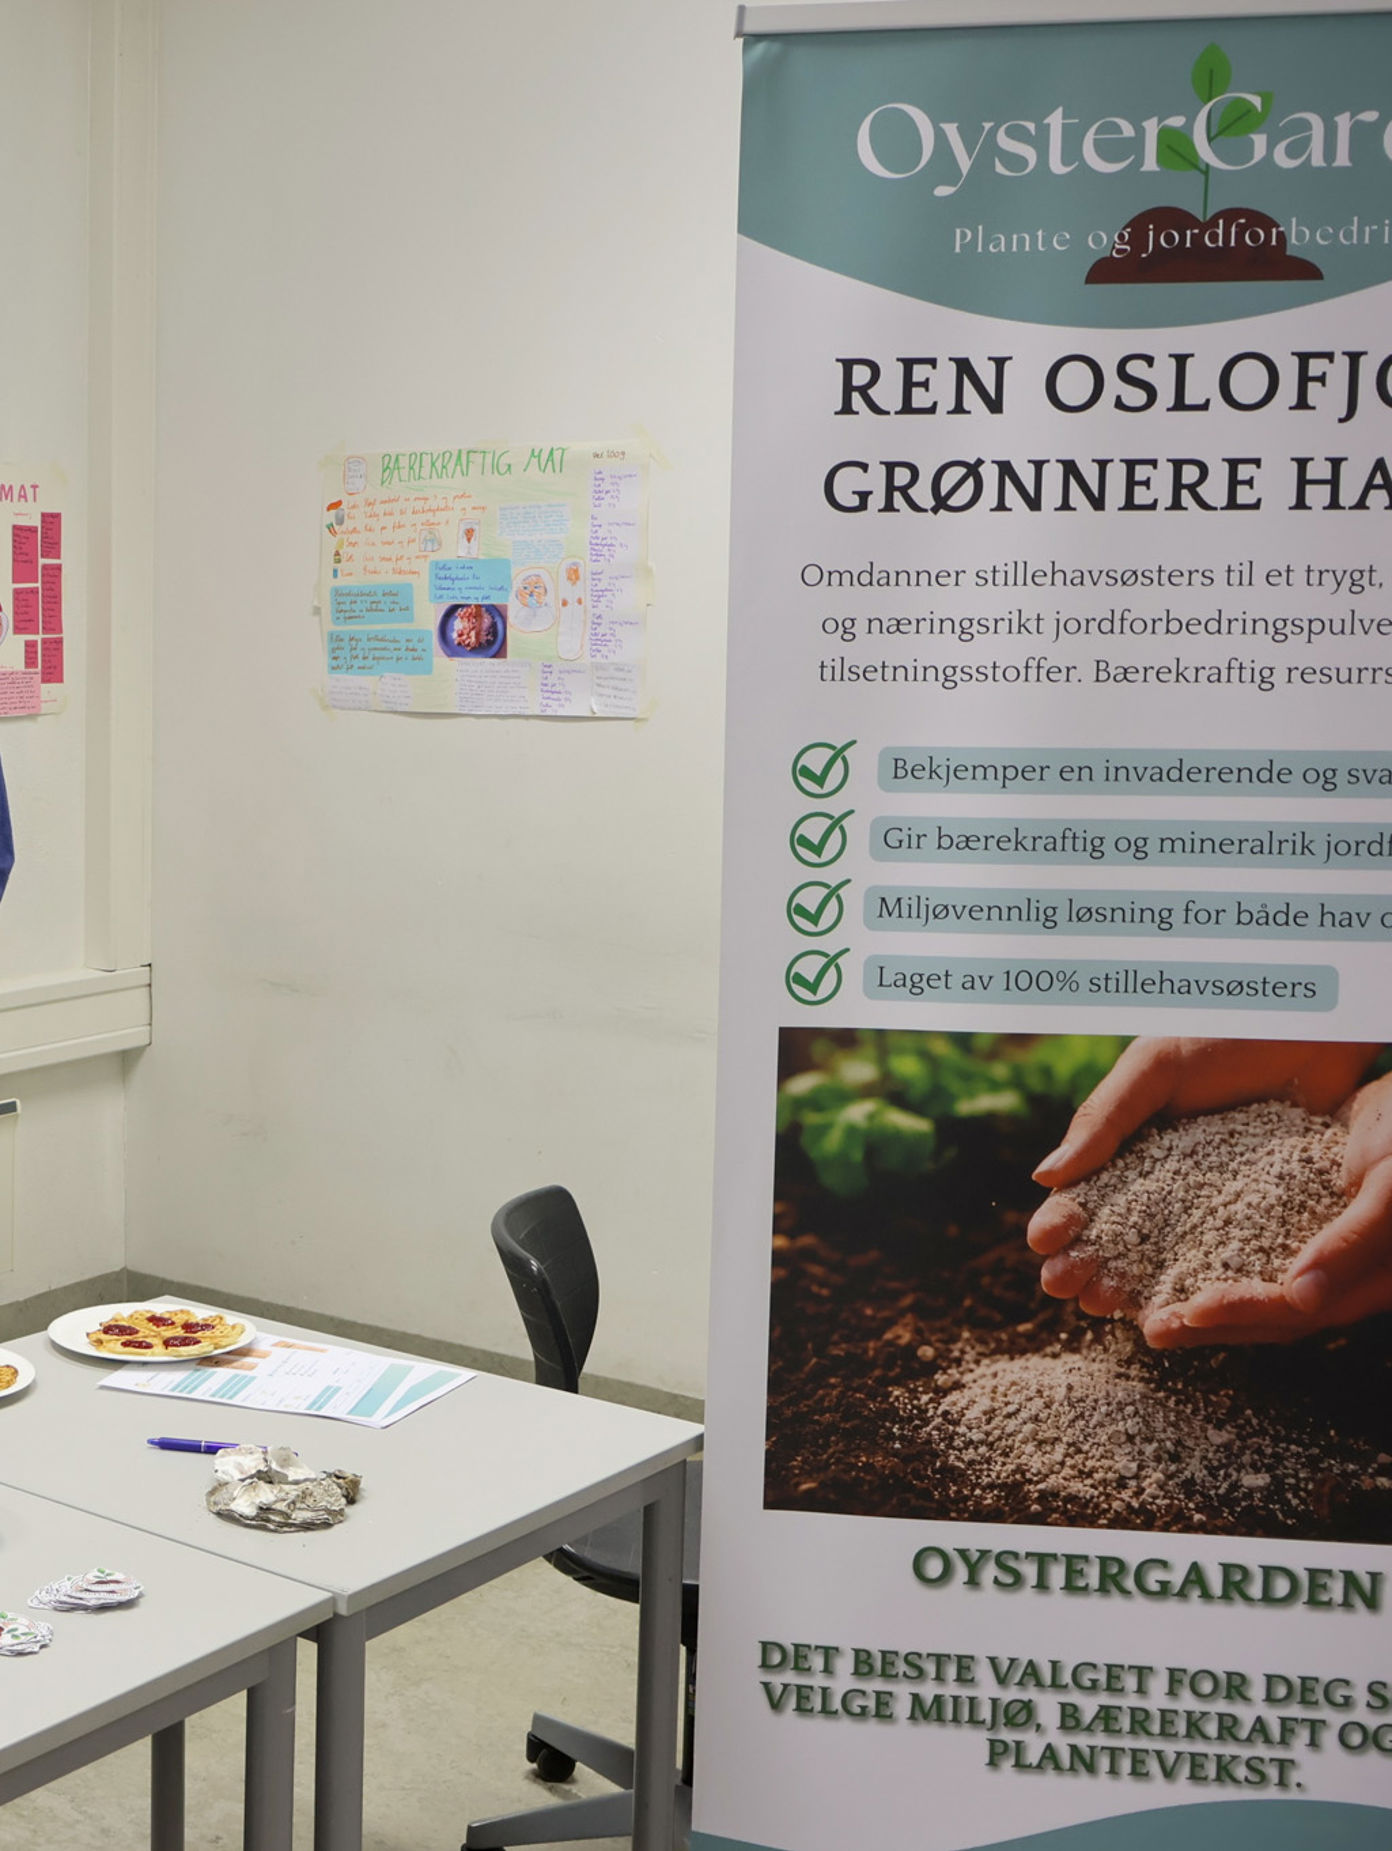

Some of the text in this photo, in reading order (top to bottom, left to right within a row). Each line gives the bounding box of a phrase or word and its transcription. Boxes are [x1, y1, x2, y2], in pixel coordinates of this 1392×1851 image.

[857, 93, 1392, 197] OysterGar
[953, 216, 1392, 258] Plante og jordforbedri
[834, 350, 1392, 424] REN OSLOFJ
[381, 447, 570, 486] BÆREKRAFTIG MAT
[824, 456, 1392, 516] GRØNNERE HA
[0, 484, 40, 503] MAT
[800, 560, 1384, 595] Omdanner stillehavsøsters til et trygt,
[821, 608, 1392, 644] og næringsrikt jordforbedringspulve
[819, 656, 1083, 691] tilsetningsstoffer.
[1093, 657, 1276, 692] Bærekraftig
[892, 757, 1392, 792] Bekjemper en invaderende og sva
[882, 827, 928, 850] Gir
[936, 826, 1106, 860] bærekraftig
[1114, 835, 1150, 861] og
[1157, 830, 1317, 857] mineralrik
[877, 896, 1059, 929] Miljøvennlig
[1067, 897, 1175, 931] løsning
[1183, 900, 1227, 926] for
[1235, 901, 1310, 928] både
[1318, 902, 1372, 928] hav
[876, 966, 1318, 999] Laget av 100% stillehavsøsters
[912, 1546, 1384, 1612] OYSTERGARDEN
[757, 1640, 840, 1675] DET
[850, 1648, 976, 1684] BESTE
[985, 1656, 1154, 1695] VALGET
[1165, 1667, 1249, 1702] FOR
[1262, 1673, 1354, 1709] DEG
[759, 1681, 895, 1720] VELGE
[906, 1692, 1043, 1734] MILJØ,
[1056, 1701, 1328, 1749] BÆREKRAFT
[984, 1737, 1305, 1789] PLANTEVEKST.
